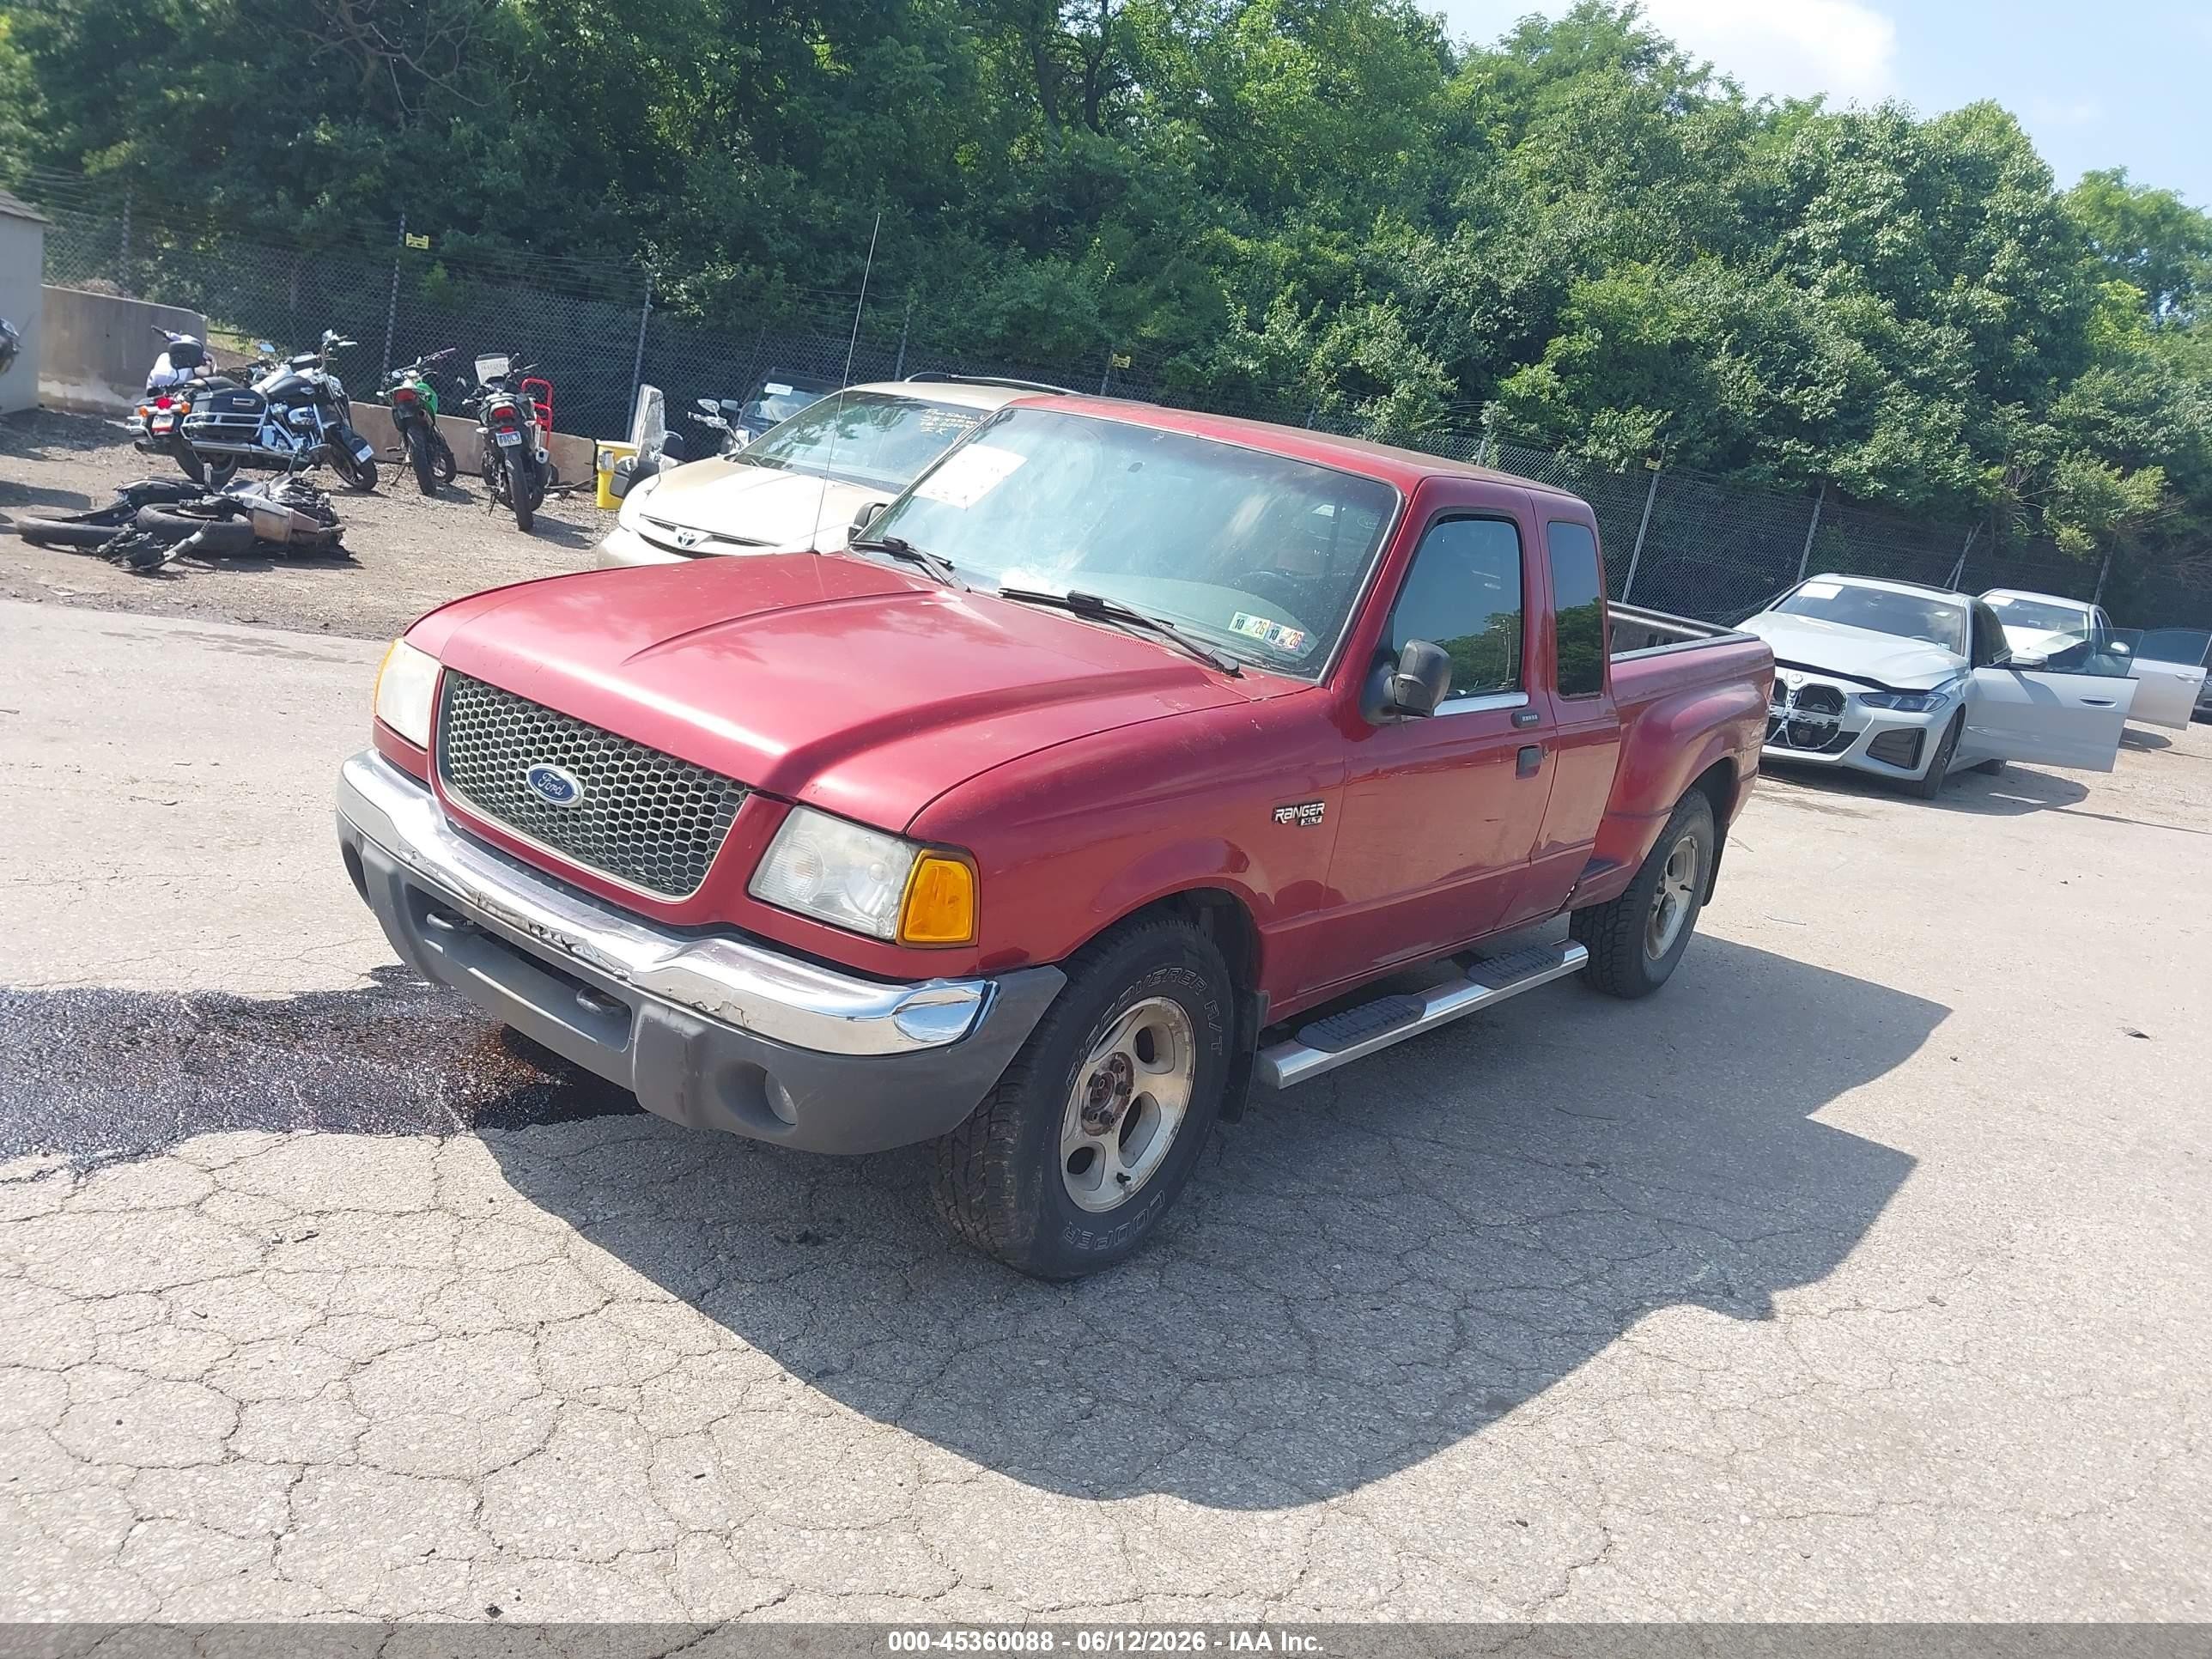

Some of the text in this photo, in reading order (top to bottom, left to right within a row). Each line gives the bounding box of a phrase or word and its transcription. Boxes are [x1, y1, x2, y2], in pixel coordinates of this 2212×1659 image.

[1234, 617, 1267, 635] 10 26
[1268, 629, 1303, 647] 10 26
[538, 772, 566, 796] Ford
[1302, 816, 1322, 825] XLT
[1064, 1189, 1166, 1250] COOPER
